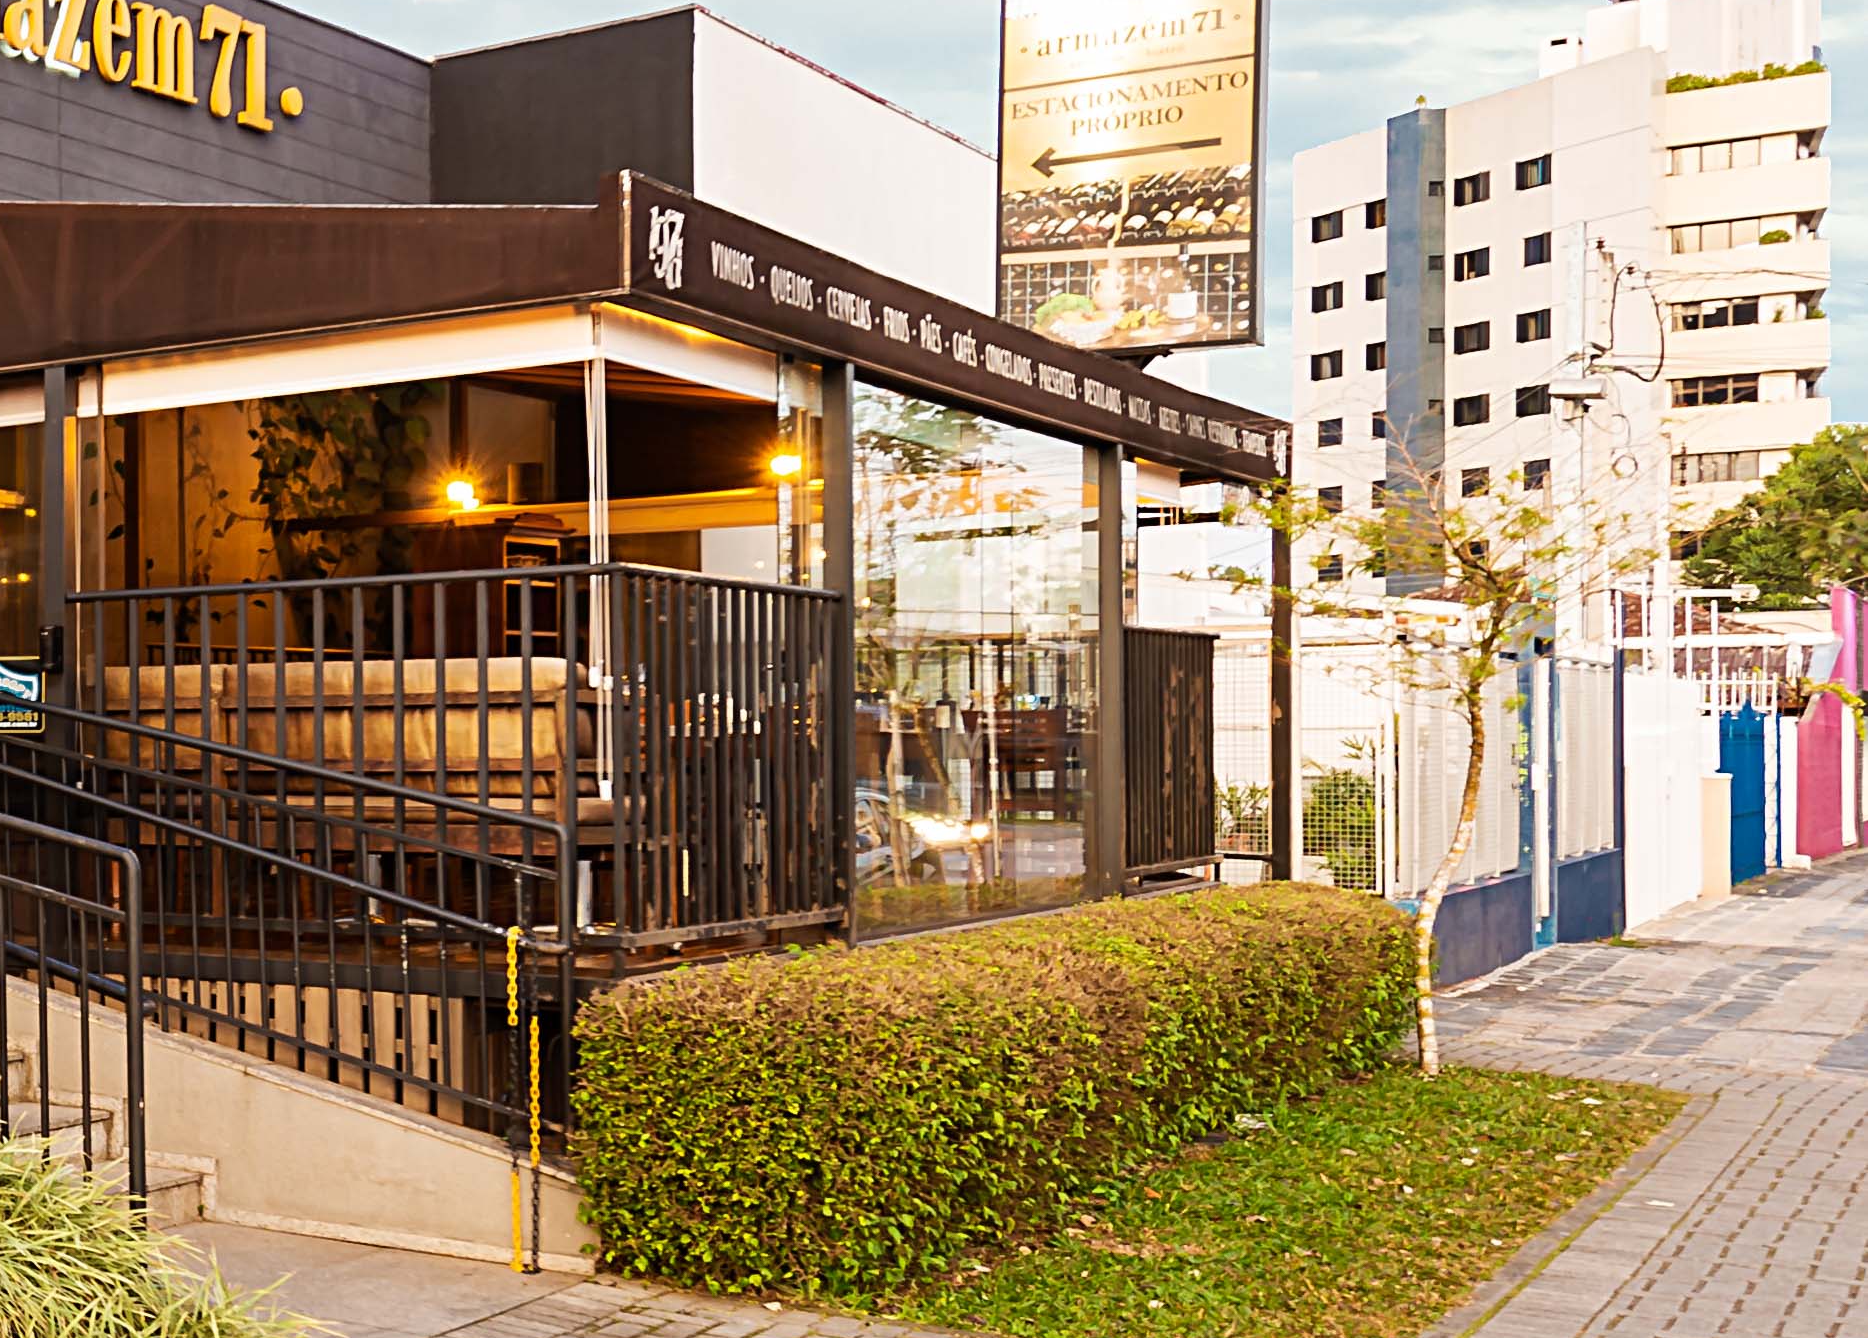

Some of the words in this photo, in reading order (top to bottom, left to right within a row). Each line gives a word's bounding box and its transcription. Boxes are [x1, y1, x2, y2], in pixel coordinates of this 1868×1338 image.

[1012, 71, 1249, 120] ESTACIONAMENTO
[1071, 105, 1184, 137] PRÓPRIO
[710, 240, 755, 291] VINHOS
[770, 265, 814, 312] QUEIJOS
[826, 286, 872, 331] CERVEJAS
[883, 306, 910, 343] FRIOS
[920, 313, 943, 355] PÃES
[952, 328, 978, 367] CAFÉS
